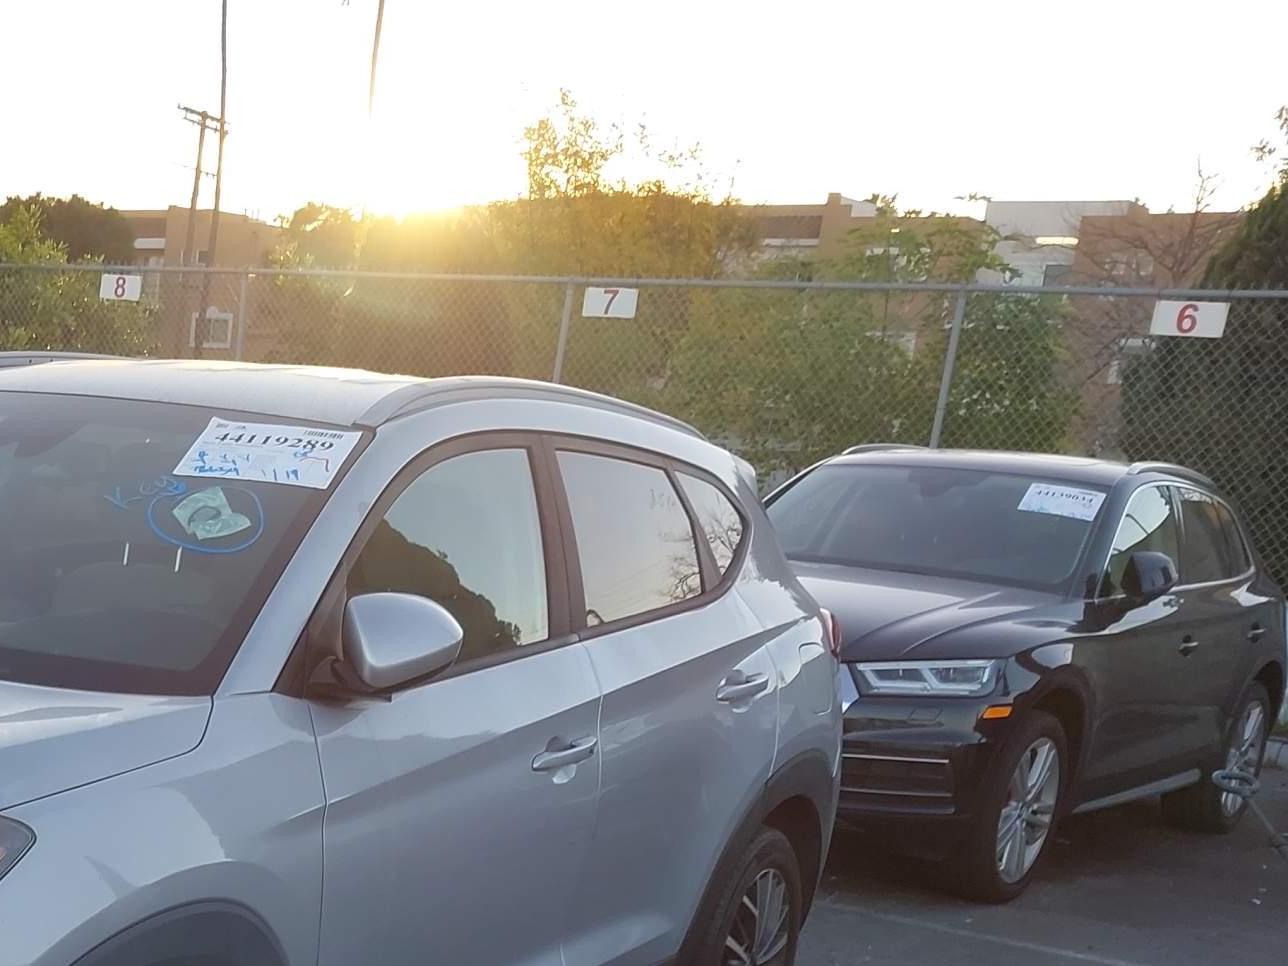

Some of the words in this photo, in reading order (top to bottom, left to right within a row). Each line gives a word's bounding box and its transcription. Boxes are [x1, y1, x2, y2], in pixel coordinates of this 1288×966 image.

[114, 276, 126, 298] 8
[604, 289, 620, 315] 7
[1176, 303, 1199, 334] 6
[214, 431, 335, 452] 44119289
